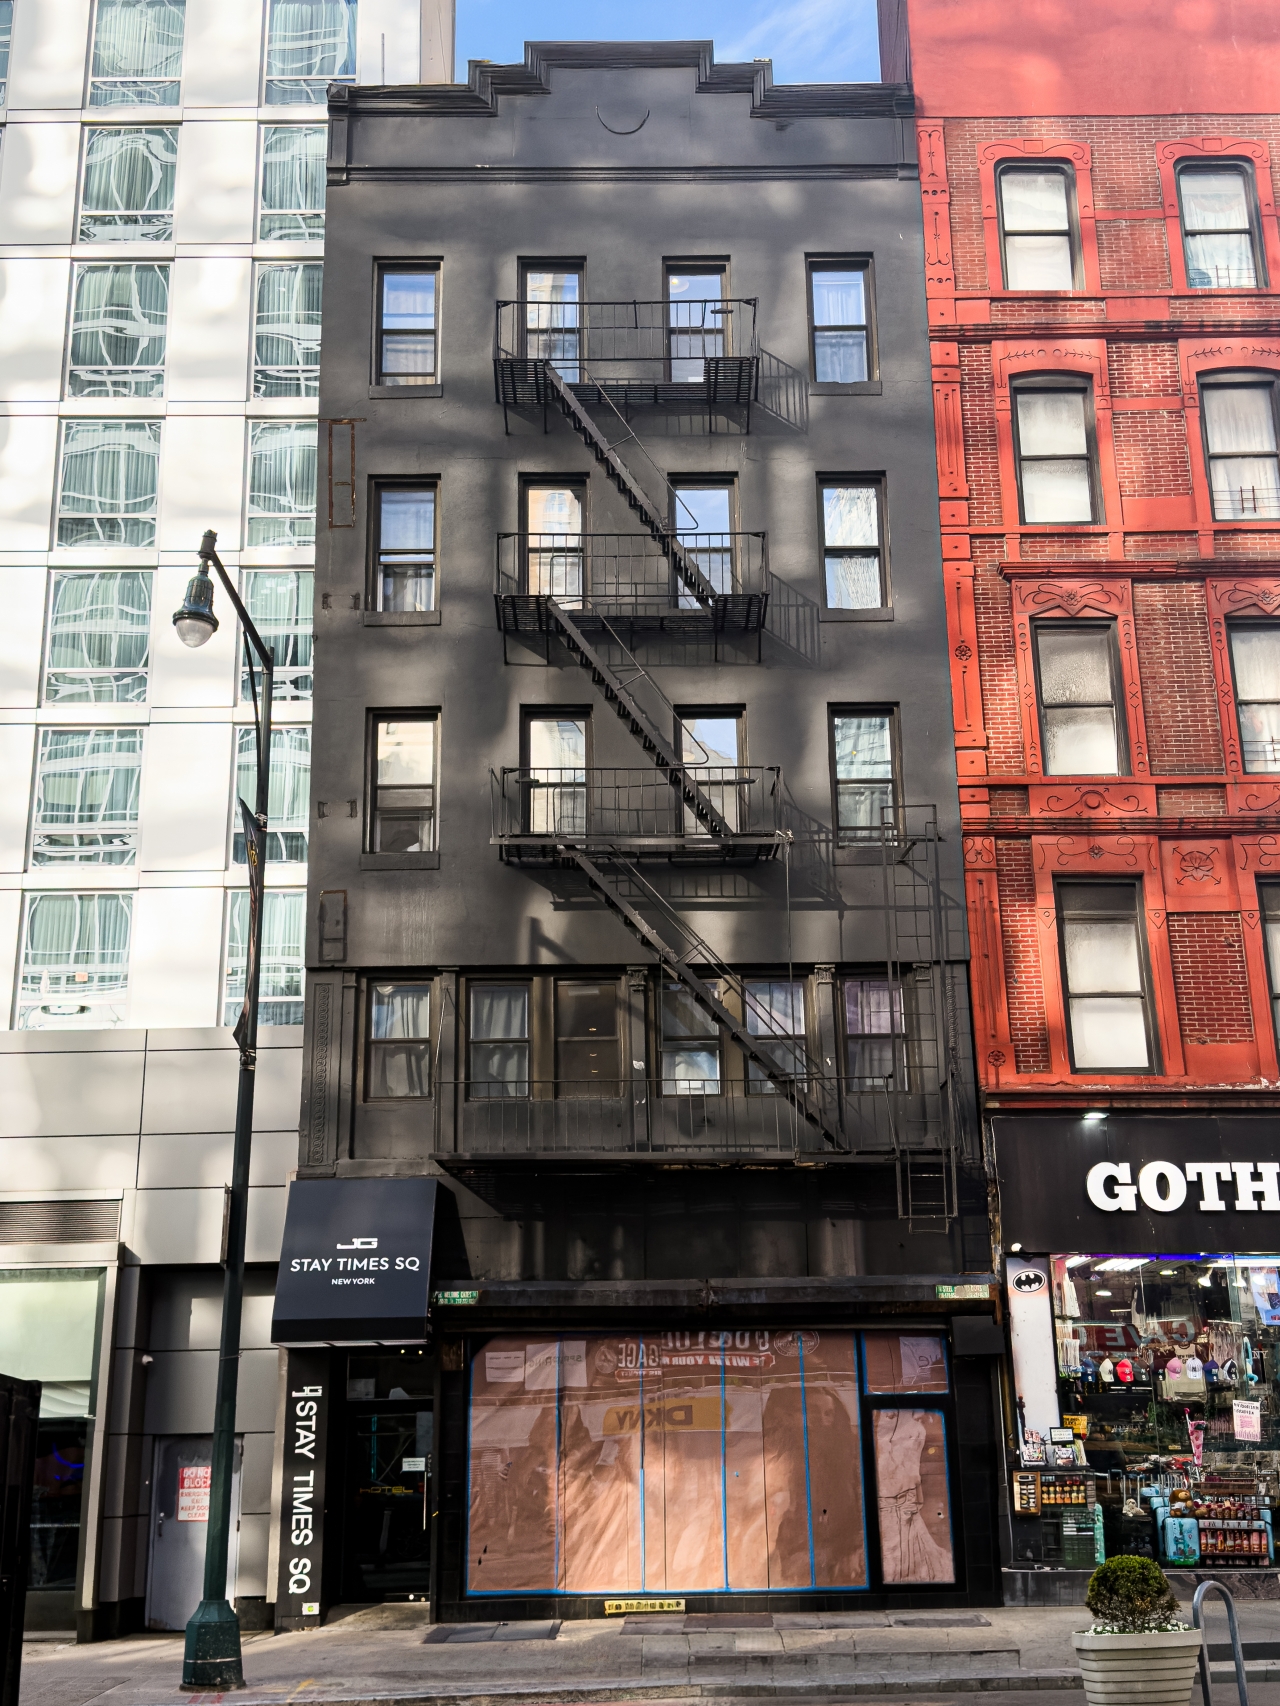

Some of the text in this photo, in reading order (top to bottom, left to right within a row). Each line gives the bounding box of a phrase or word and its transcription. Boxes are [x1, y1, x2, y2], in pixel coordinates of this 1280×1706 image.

[290, 1256, 420, 1272] STAY TIMES SQ
[352, 1277, 375, 1285] YORK
[183, 1469, 211, 1478] DO NO
[360, 1486, 414, 1494] HOTEL
[289, 1401, 318, 1594] STAY TIMES SQ
